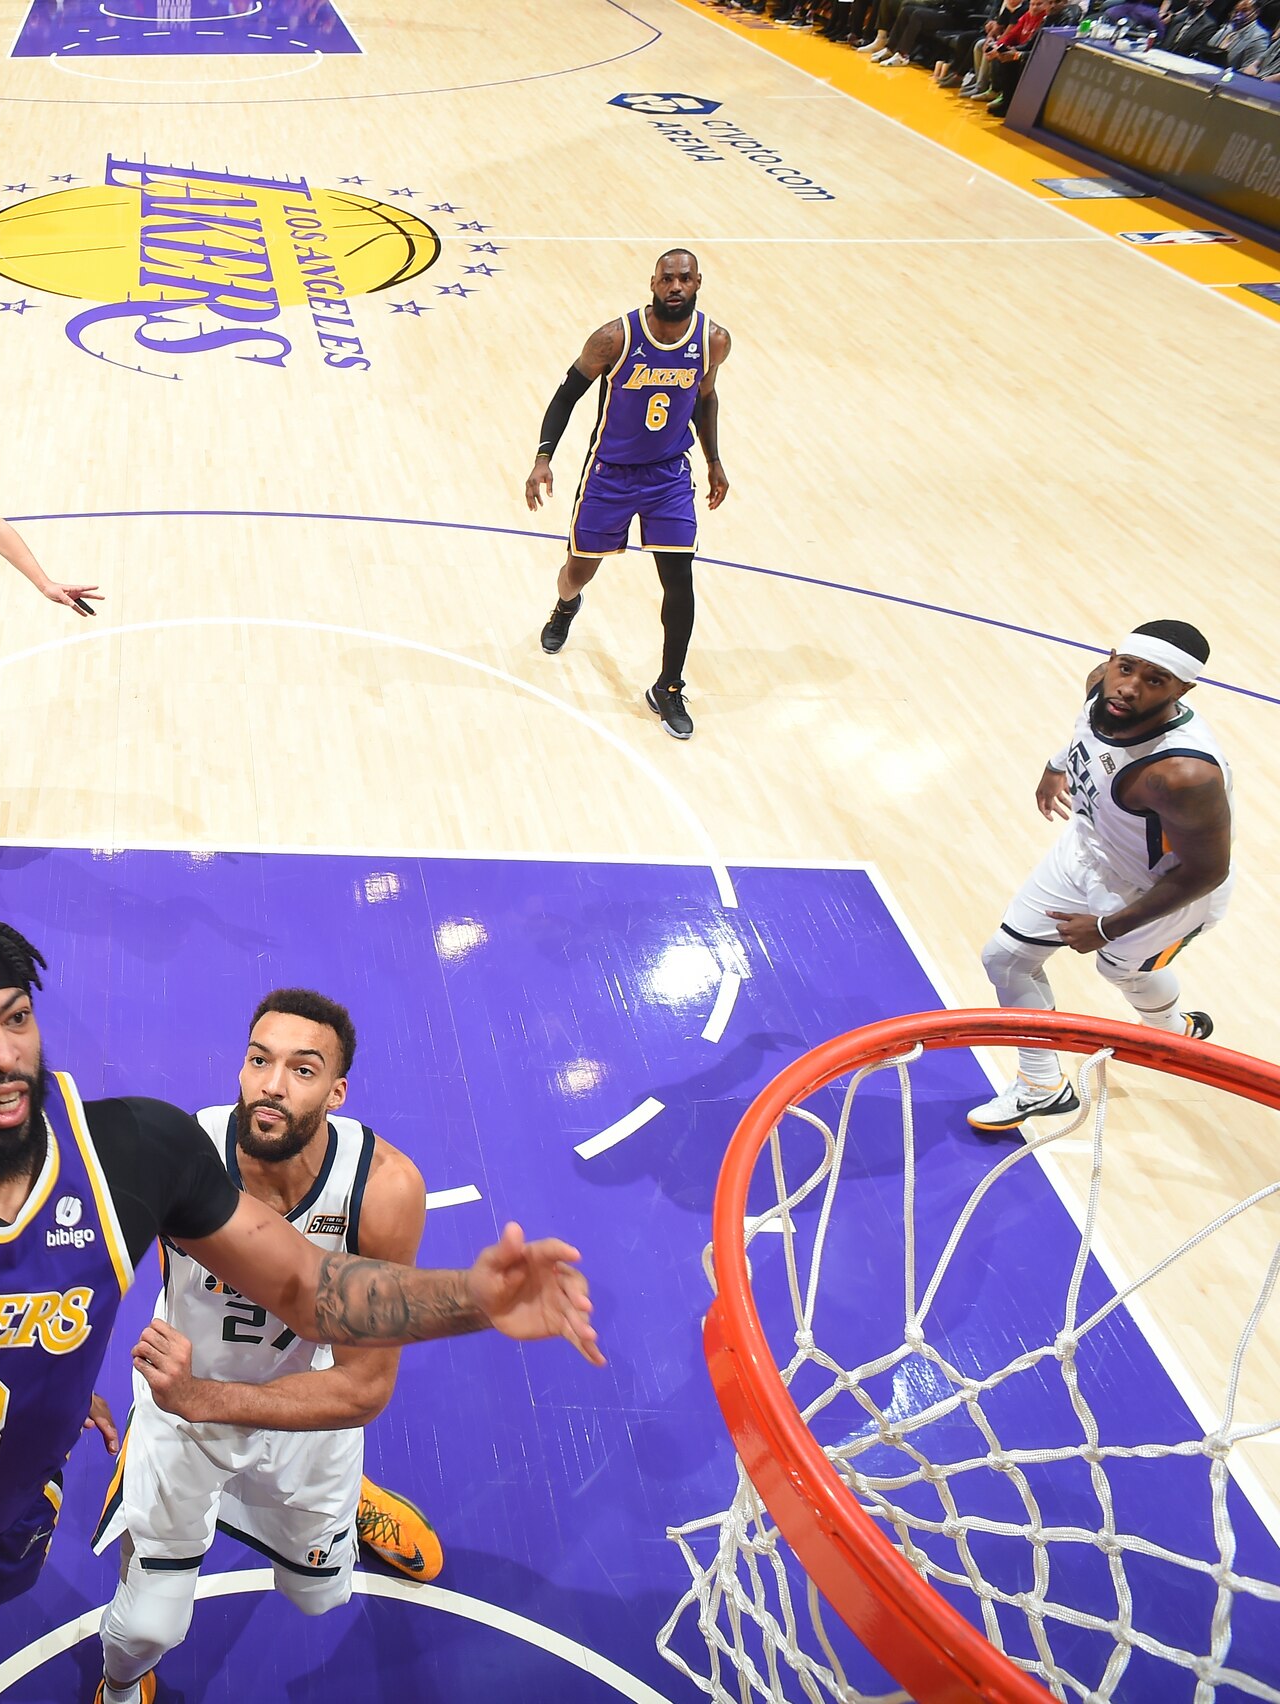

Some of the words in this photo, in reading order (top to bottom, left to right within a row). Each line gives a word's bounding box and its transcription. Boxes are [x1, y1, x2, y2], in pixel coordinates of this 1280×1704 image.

[647, 120, 726, 163] ARENA
[701, 119, 836, 201] crypto.com
[282, 204, 328, 242] LOS
[65, 152, 313, 381] LAKERS
[293, 243, 372, 372] ANGELES
[621, 363, 698, 390] LAKERS
[645, 392, 671, 432] 6
[46, 1227, 95, 1249] bibigo
[310, 1217, 323, 1232] 5
[321, 1224, 345, 1234] FIGHT
